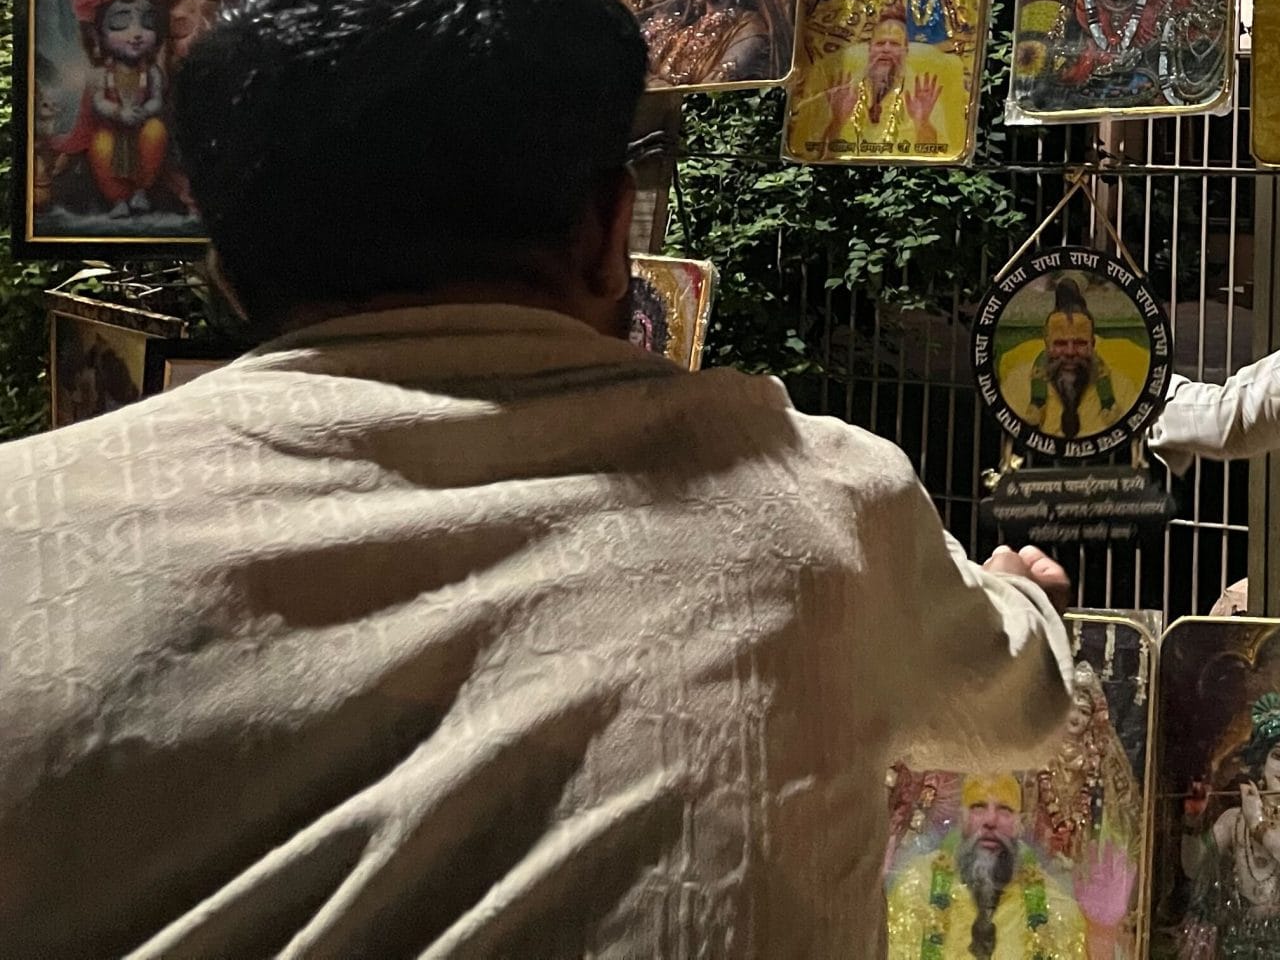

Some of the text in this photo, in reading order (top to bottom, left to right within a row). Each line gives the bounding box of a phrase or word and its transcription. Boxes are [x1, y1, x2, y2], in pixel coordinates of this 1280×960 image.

[1031, 252, 1061, 272] राधा
[1069, 252, 1099, 269] राधा
[1107, 260, 1135, 287] राधा
[999, 268, 1027, 293] राधा
[980, 295, 1002, 326] राधा
[1137, 287, 1159, 317] राधा
